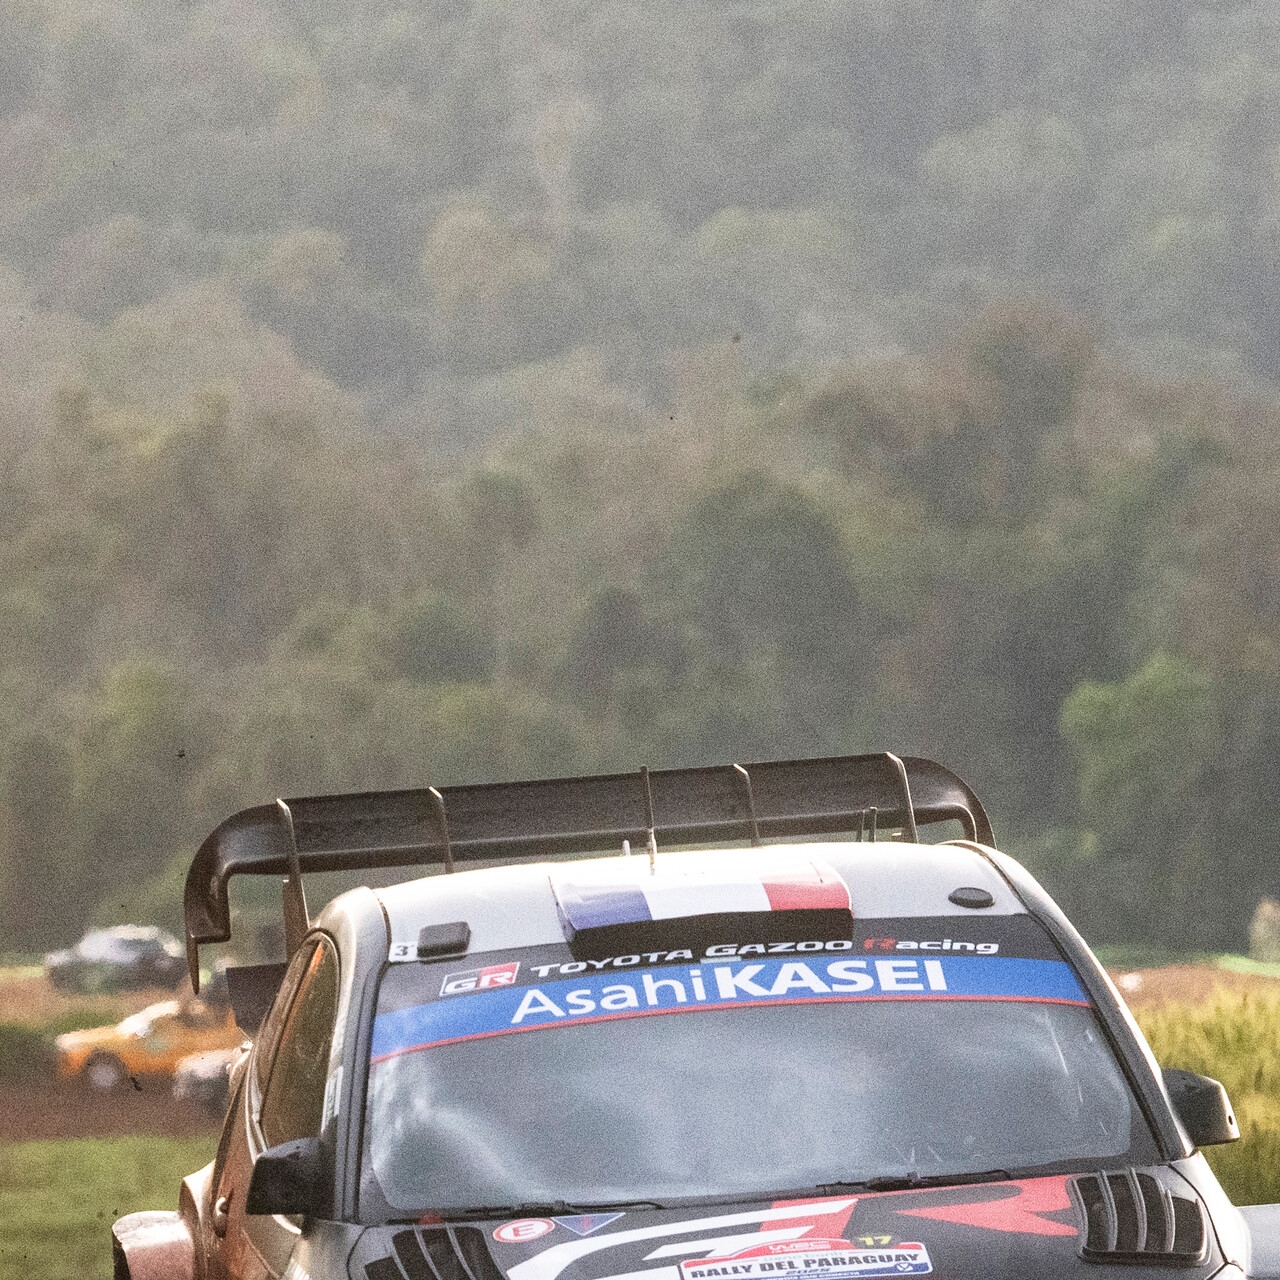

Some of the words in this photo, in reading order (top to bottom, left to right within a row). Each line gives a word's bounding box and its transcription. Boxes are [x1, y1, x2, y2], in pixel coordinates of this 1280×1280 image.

[530, 948, 694, 978] TOYOTA
[705, 940, 853, 956] GAZOO
[863, 938, 1000, 955] Racing
[444, 970, 515, 994] GR
[858, 1235, 892, 1245] 17
[691, 1264, 753, 1278] RALLY
[760, 1259, 799, 1272] DEL
[803, 1253, 919, 1269] PARAGUAY
